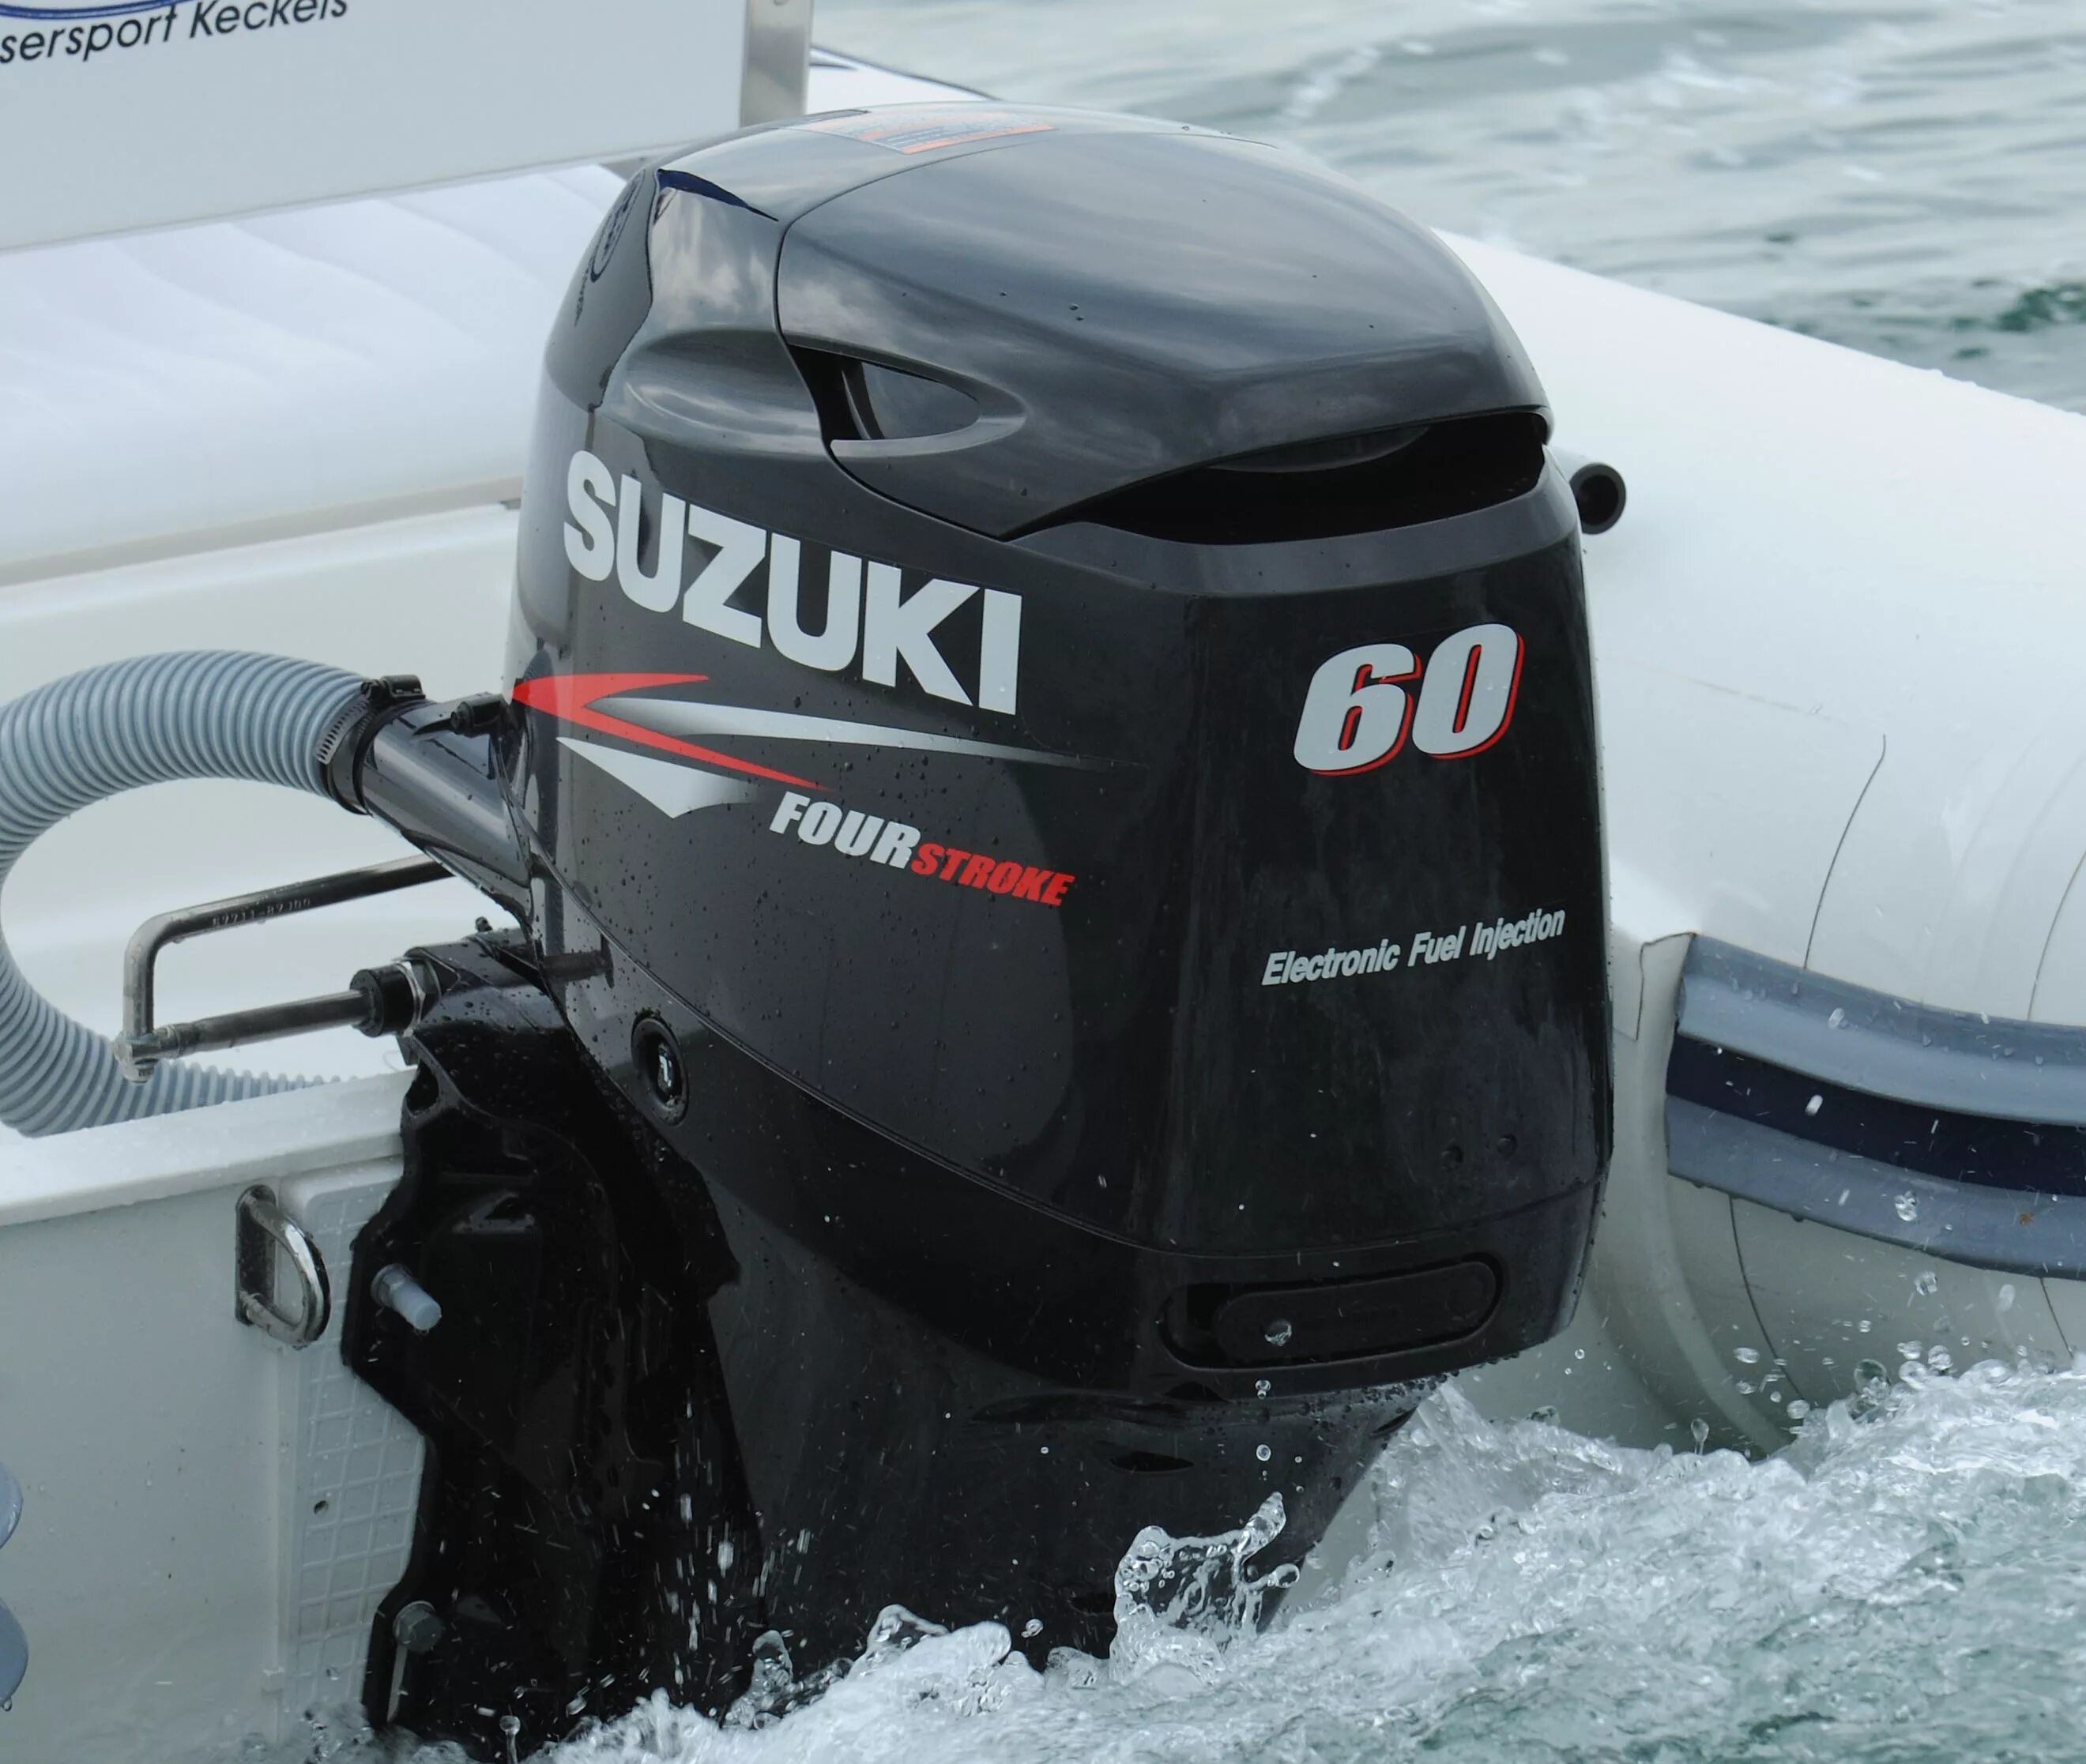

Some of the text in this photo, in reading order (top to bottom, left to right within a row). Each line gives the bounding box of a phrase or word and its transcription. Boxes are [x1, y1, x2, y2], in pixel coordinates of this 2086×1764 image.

[563, 450, 1022, 715] SUZUKI
[1293, 623, 1525, 777] 60
[1261, 908, 1566, 986] Electronic Fuel Injection
